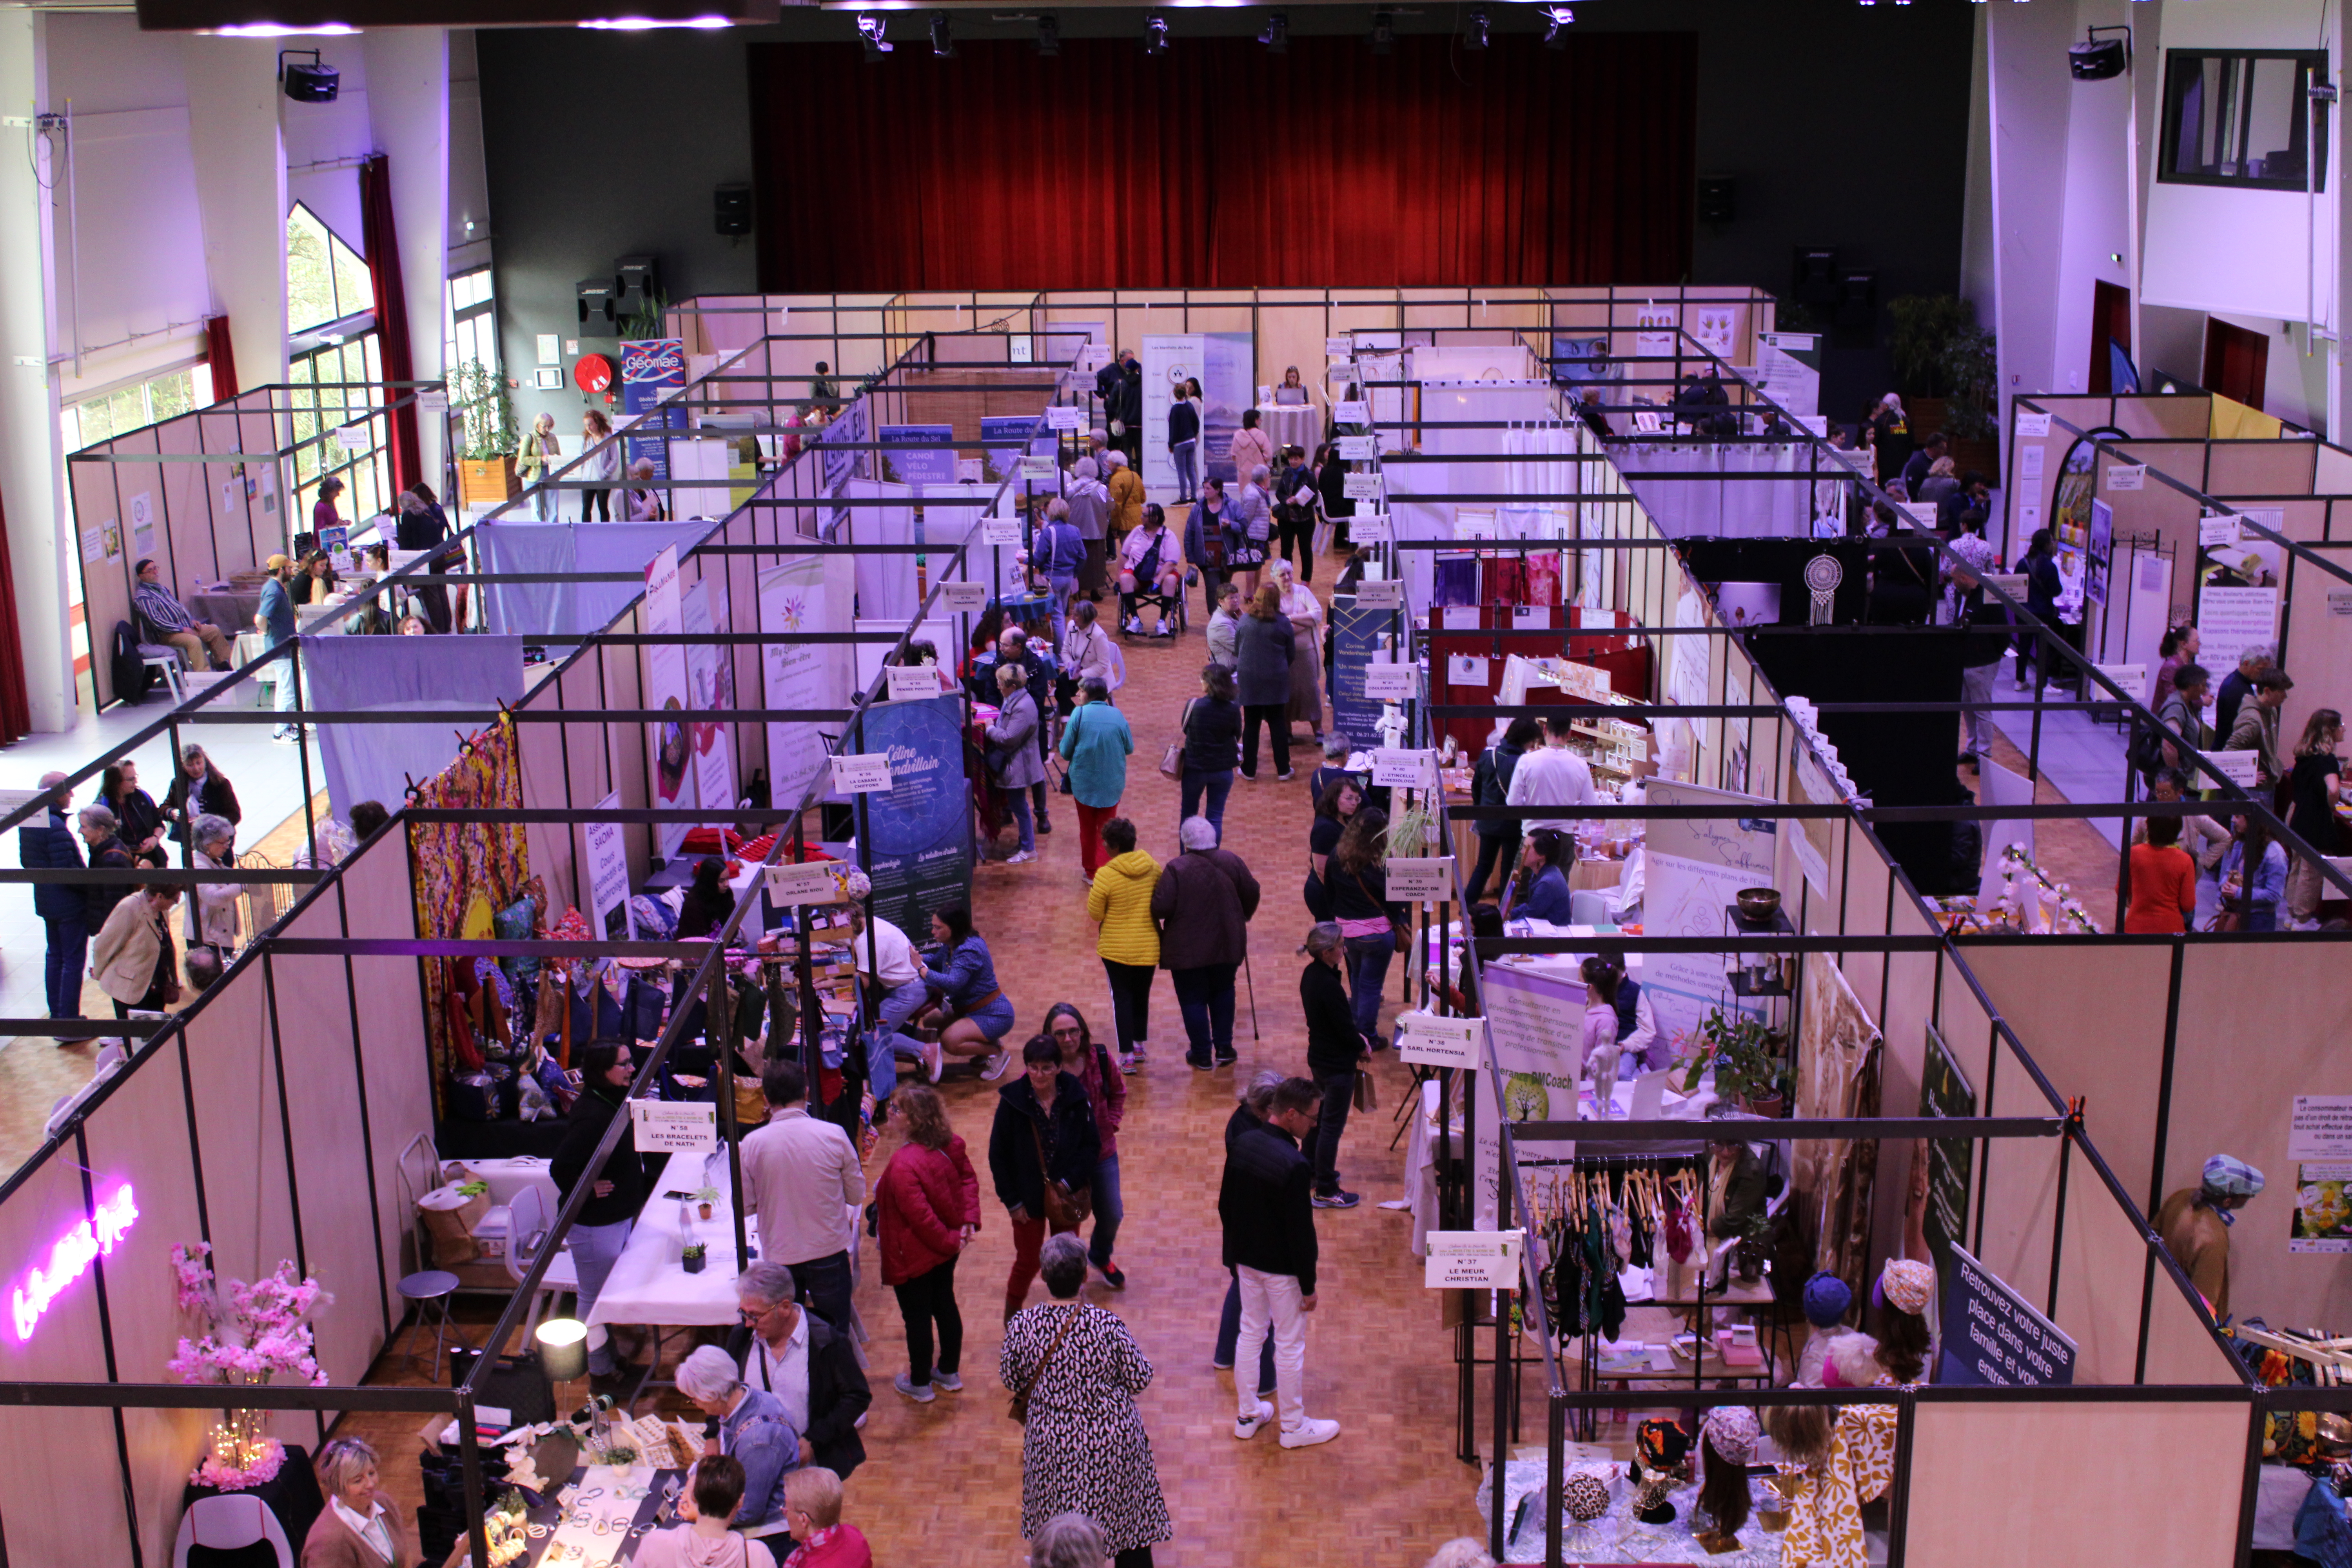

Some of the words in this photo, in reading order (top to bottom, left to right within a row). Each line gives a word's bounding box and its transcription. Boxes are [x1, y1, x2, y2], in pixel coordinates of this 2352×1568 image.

[626, 356, 679, 370] Géomae
[906, 451, 935, 461] CANOË
[906, 461, 928, 470] VÉLO
[907, 471, 946, 480] PÉDESTRE
[887, 745, 917, 764] Céline
[595, 826, 614, 850] SAONA
[600, 851, 615, 869] Cours
[594, 866, 617, 892] collectifs
[618, 860, 624, 872] de
[1651, 857, 1664, 866] Agir
[1677, 862, 1686, 870] les
[1688, 864, 1719, 878] différents
[1720, 873, 1738, 882] plans
[1739, 875, 1748, 884] de
[597, 875, 627, 907] sophrologie
[1670, 963, 1688, 974] Grâce
[1665, 973, 1697, 986] méthodes
[1508, 996, 1551, 1012] Consultante
[1487, 1002, 1542, 1022] développement
[1543, 1016, 1579, 1032] personnel,
[1494, 1016, 1555, 1035] accompagnatrice
[1556, 1031, 1572, 1040] d'un
[1493, 1027, 1525, 1040] coaching
[1537, 1038, 1572, 1051] transition
[1426, 1047, 1465, 1056] HORTENSIA
[1505, 1040, 1559, 1059] professionnelle
[1521, 1149, 1542, 1160] votre
[1960, 1261, 2012, 1318] Retrouvez
[1967, 1298, 1996, 1330] place
[1997, 1321, 2023, 1354] dans
[2025, 1345, 2053, 1379] votre
[2014, 1308, 2040, 1341] votre
[2040, 1329, 2068, 1365] juste
[1969, 1321, 2003, 1363] famille
[2005, 1355, 2016, 1374] et
